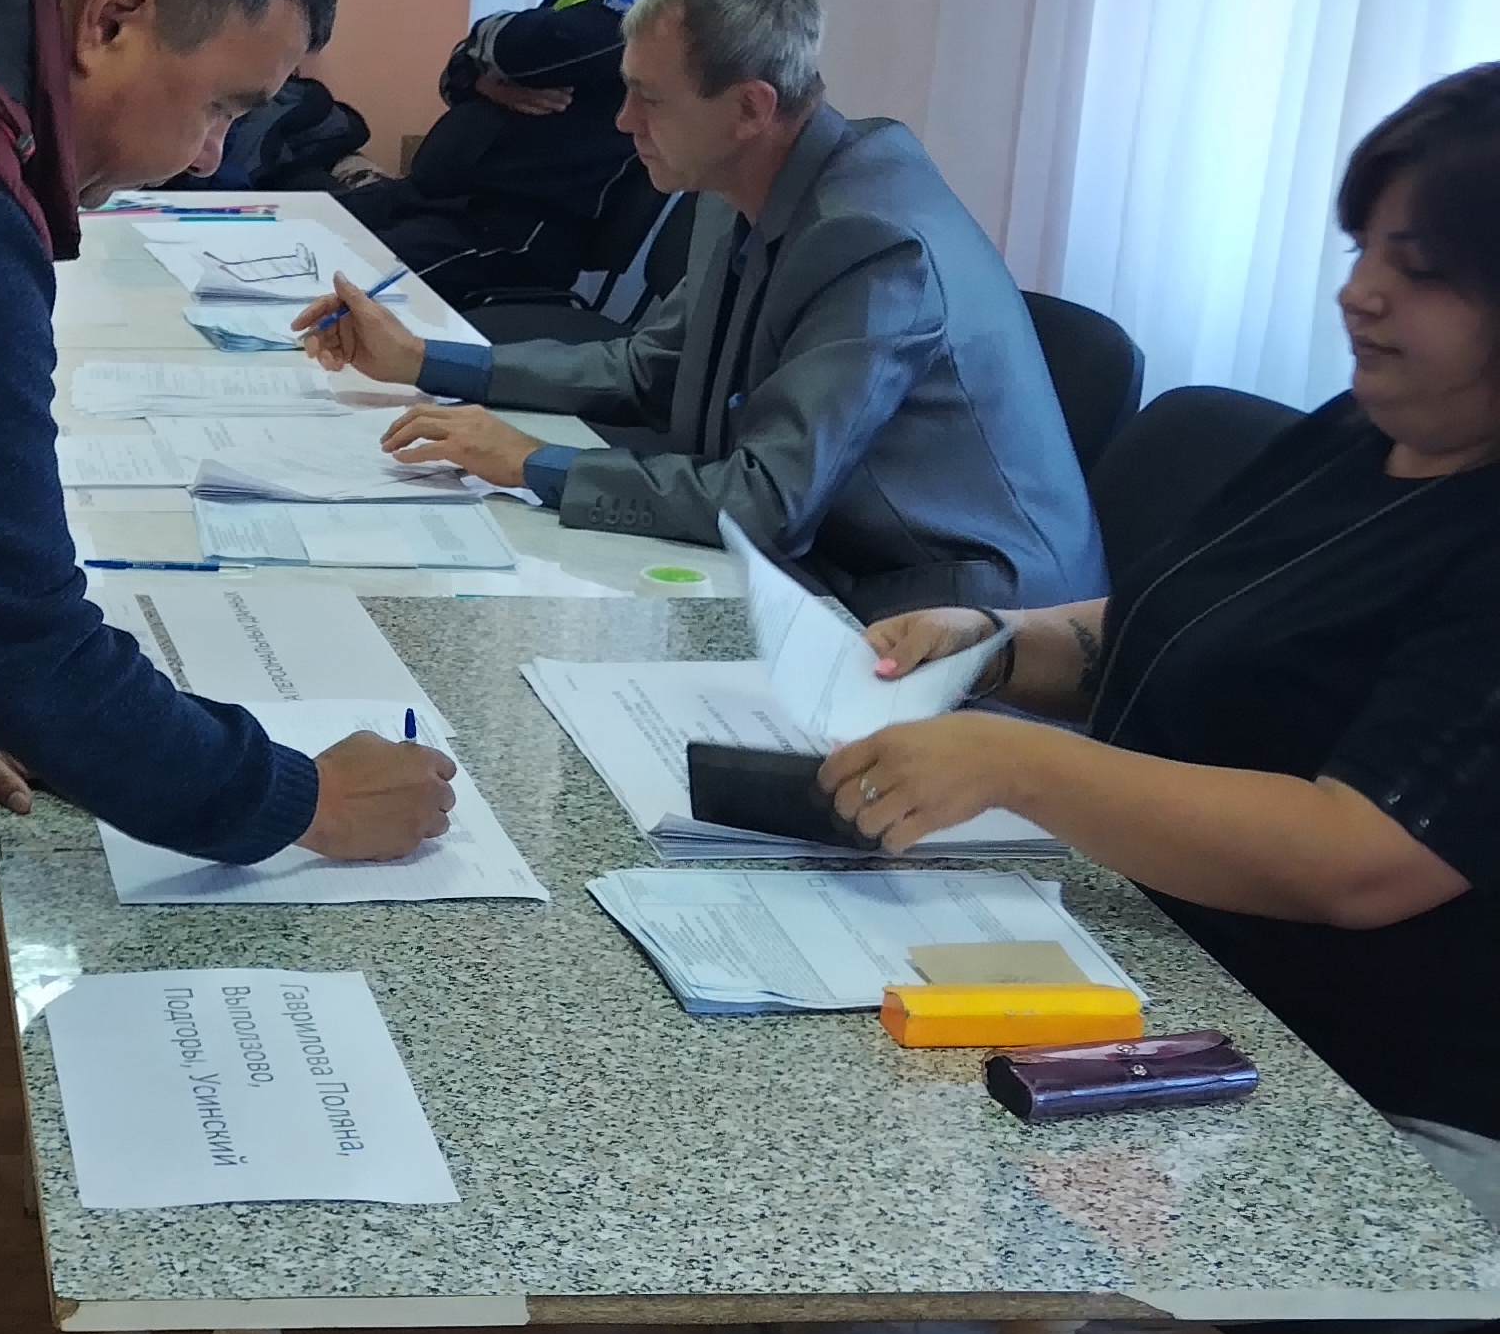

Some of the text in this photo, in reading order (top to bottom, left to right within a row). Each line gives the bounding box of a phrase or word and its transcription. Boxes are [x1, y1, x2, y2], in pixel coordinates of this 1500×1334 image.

[223, 590, 260, 624] ДАННЫХ
[242, 624, 298, 694] ПЕРСОНАЛЬНЫХ
[163, 987, 249, 1167] Подгоры, Усинский
[221, 985, 275, 1088] Выползово,
[279, 983, 365, 1157] Гаврилова Поляна,
